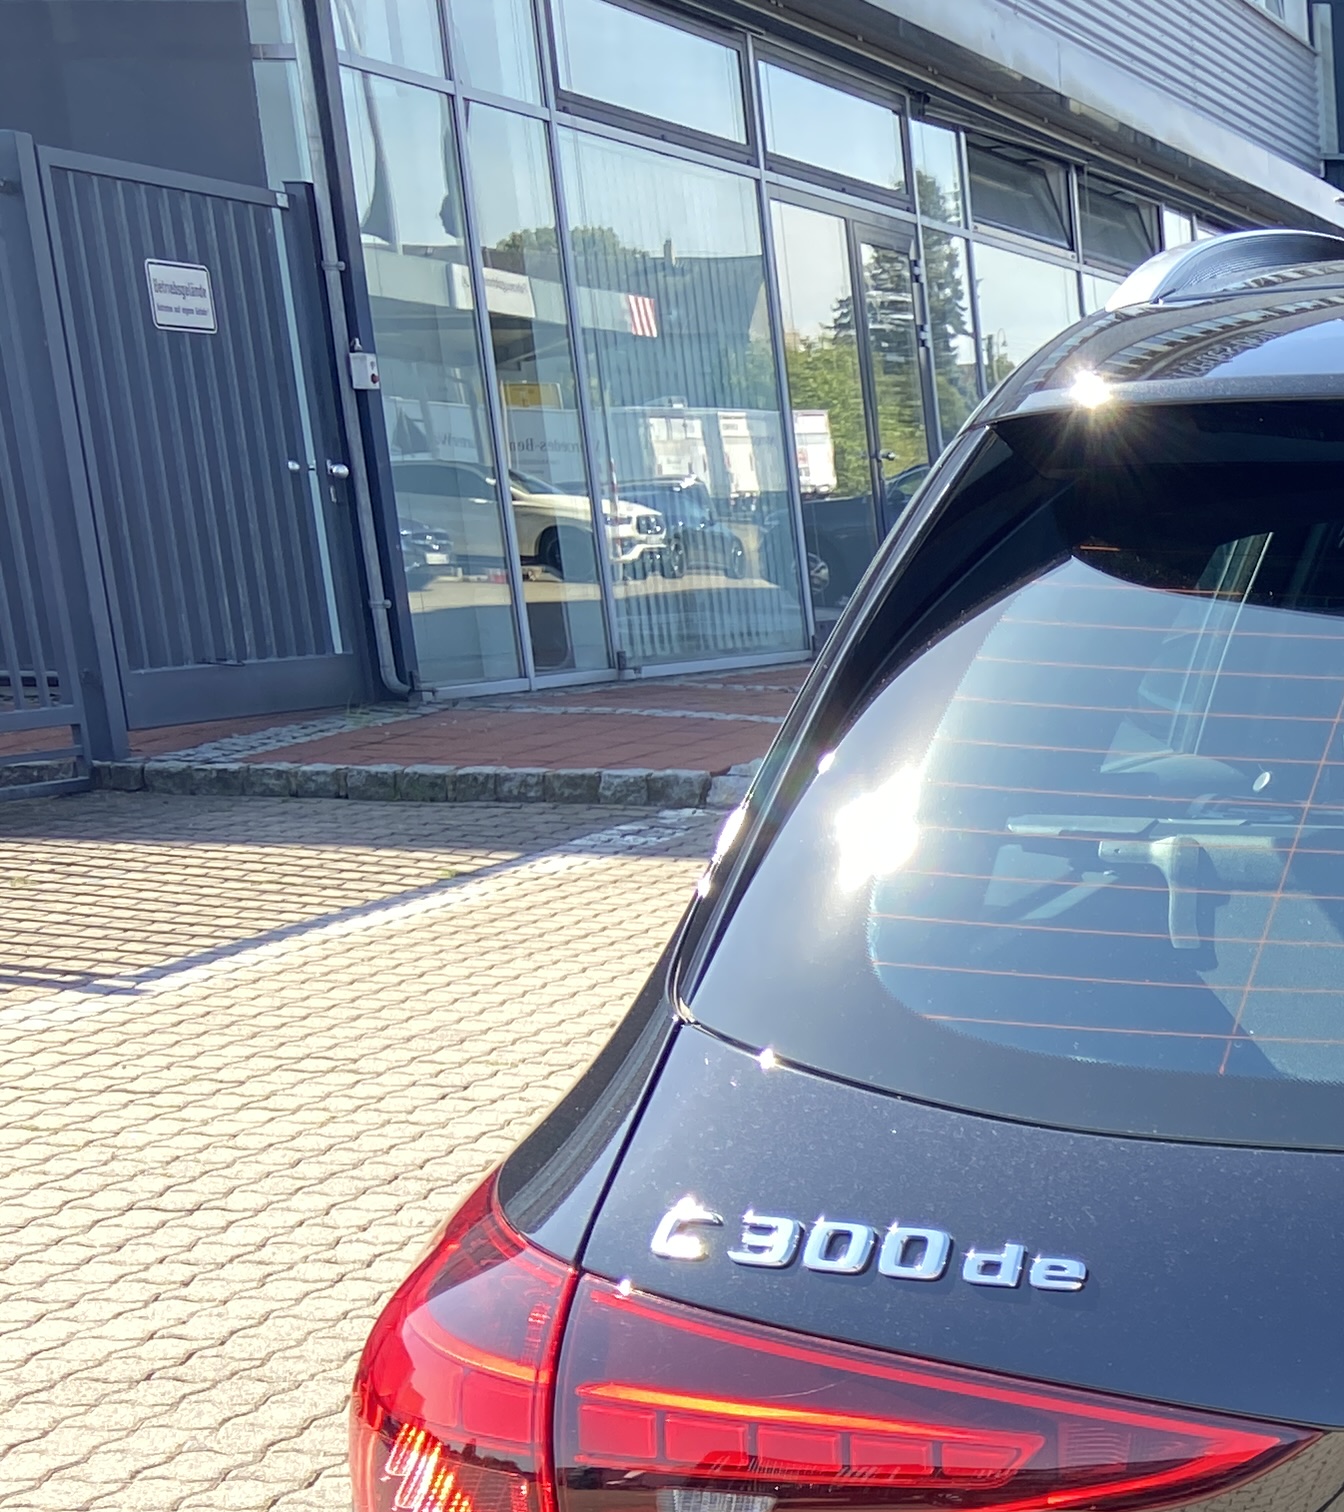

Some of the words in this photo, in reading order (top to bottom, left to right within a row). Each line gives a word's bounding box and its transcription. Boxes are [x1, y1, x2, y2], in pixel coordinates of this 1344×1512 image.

[650, 1197, 724, 1260] C
[727, 1210, 952, 1282] 300
[962, 1242, 1088, 1292] de
